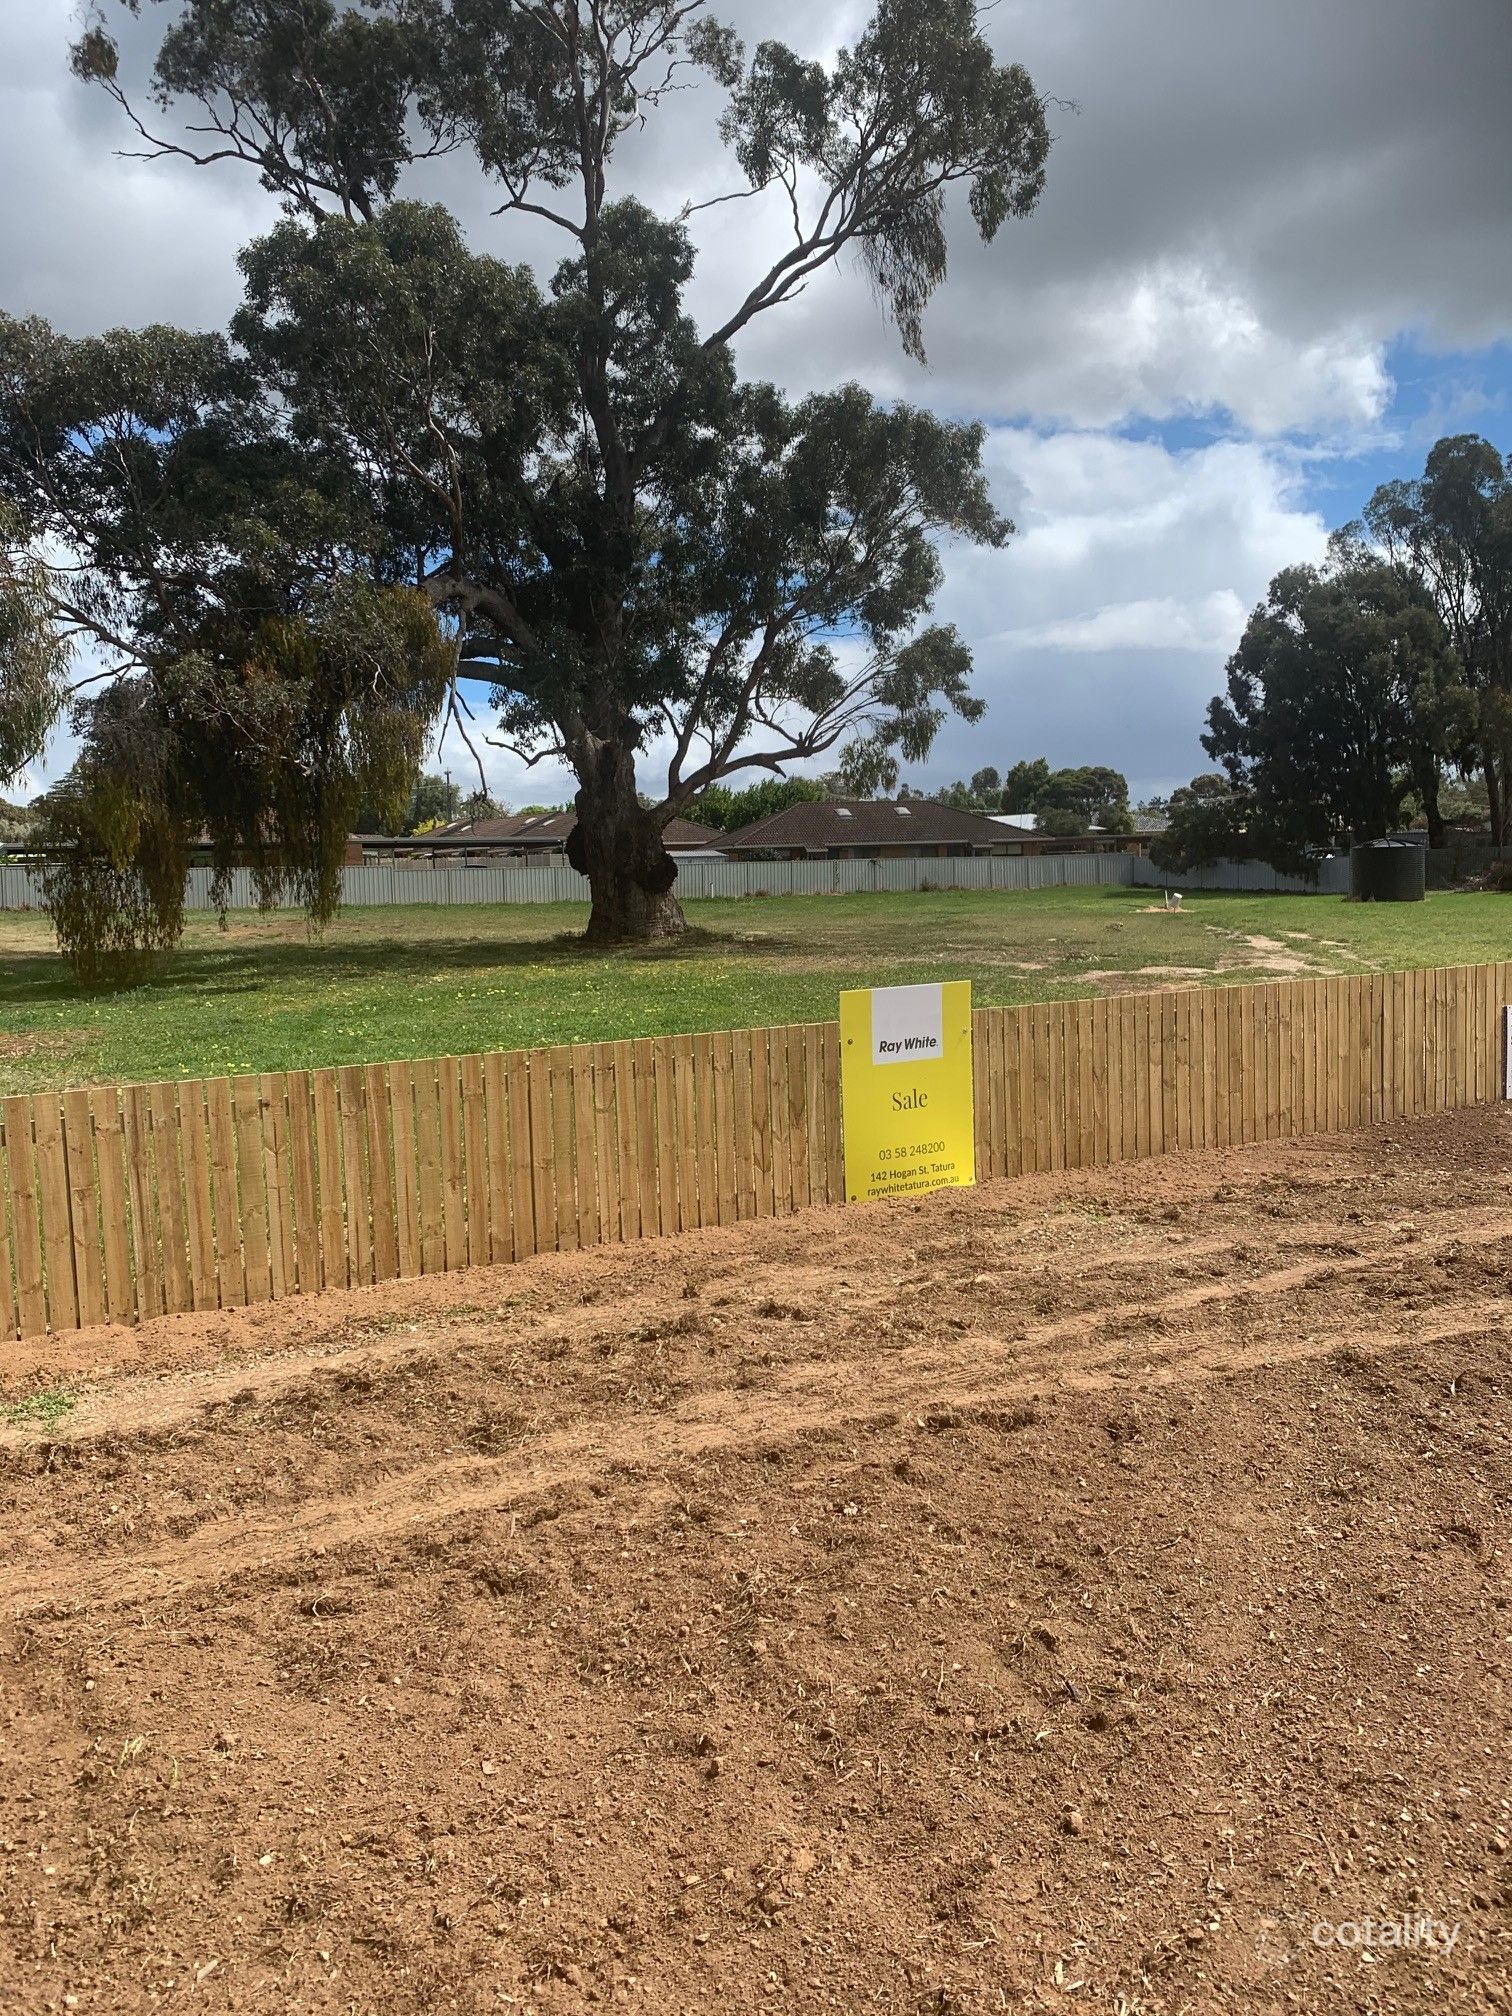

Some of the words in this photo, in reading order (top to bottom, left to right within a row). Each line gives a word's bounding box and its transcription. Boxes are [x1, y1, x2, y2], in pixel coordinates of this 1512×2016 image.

[879, 1041, 902, 1053] Ray
[892, 1088, 928, 1111] Sale
[879, 1149, 892, 1160] 03
[894, 1147, 907, 1158] 58
[909, 1141, 945, 1156] 248200
[870, 1171, 887, 1182] 142
[889, 1168, 917, 1179] Hogan
[930, 1162, 955, 1173] Tatura
[867, 1175, 959, 1196] raywhitetatura.com.au
